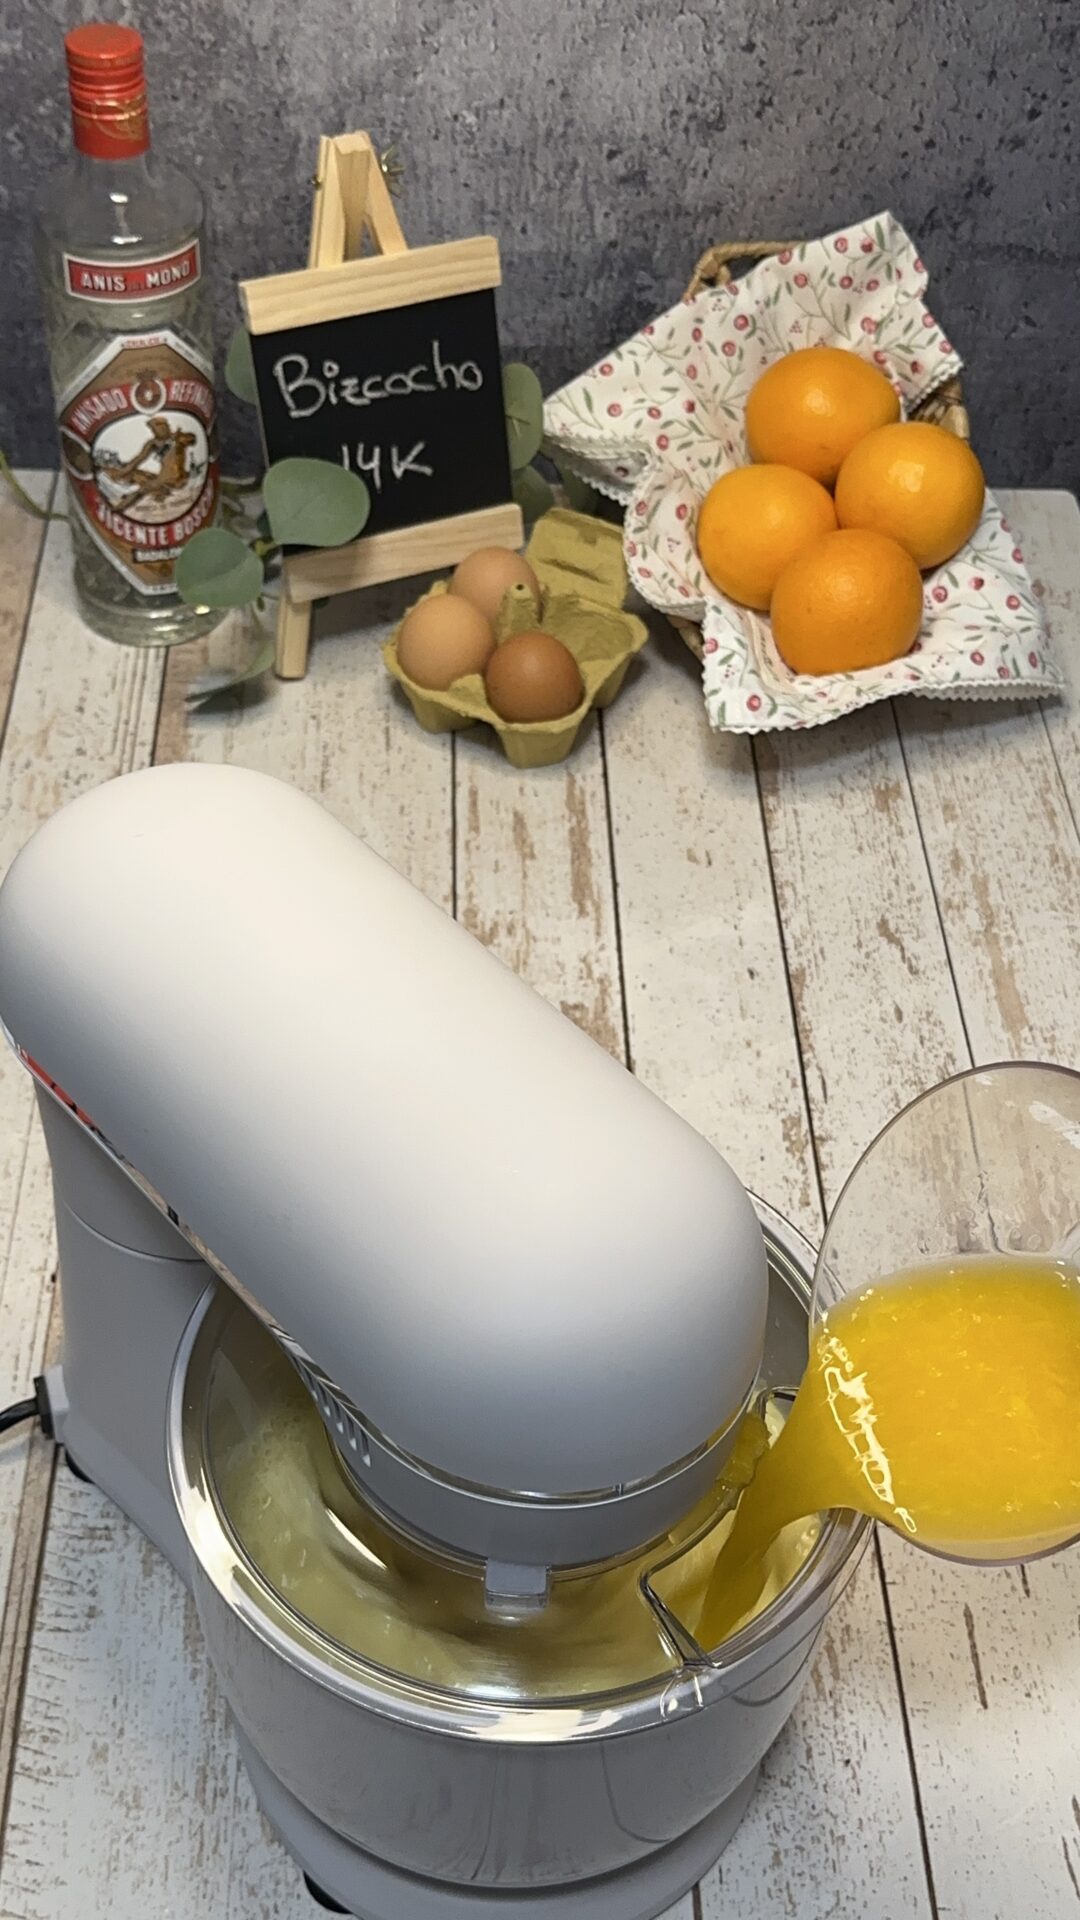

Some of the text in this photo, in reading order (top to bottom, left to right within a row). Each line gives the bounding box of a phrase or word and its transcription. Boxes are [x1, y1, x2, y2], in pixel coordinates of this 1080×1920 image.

[82, 272, 126, 293] ANIS
[146, 260, 190, 288] MONO
[273, 340, 483, 418] Bizcocho
